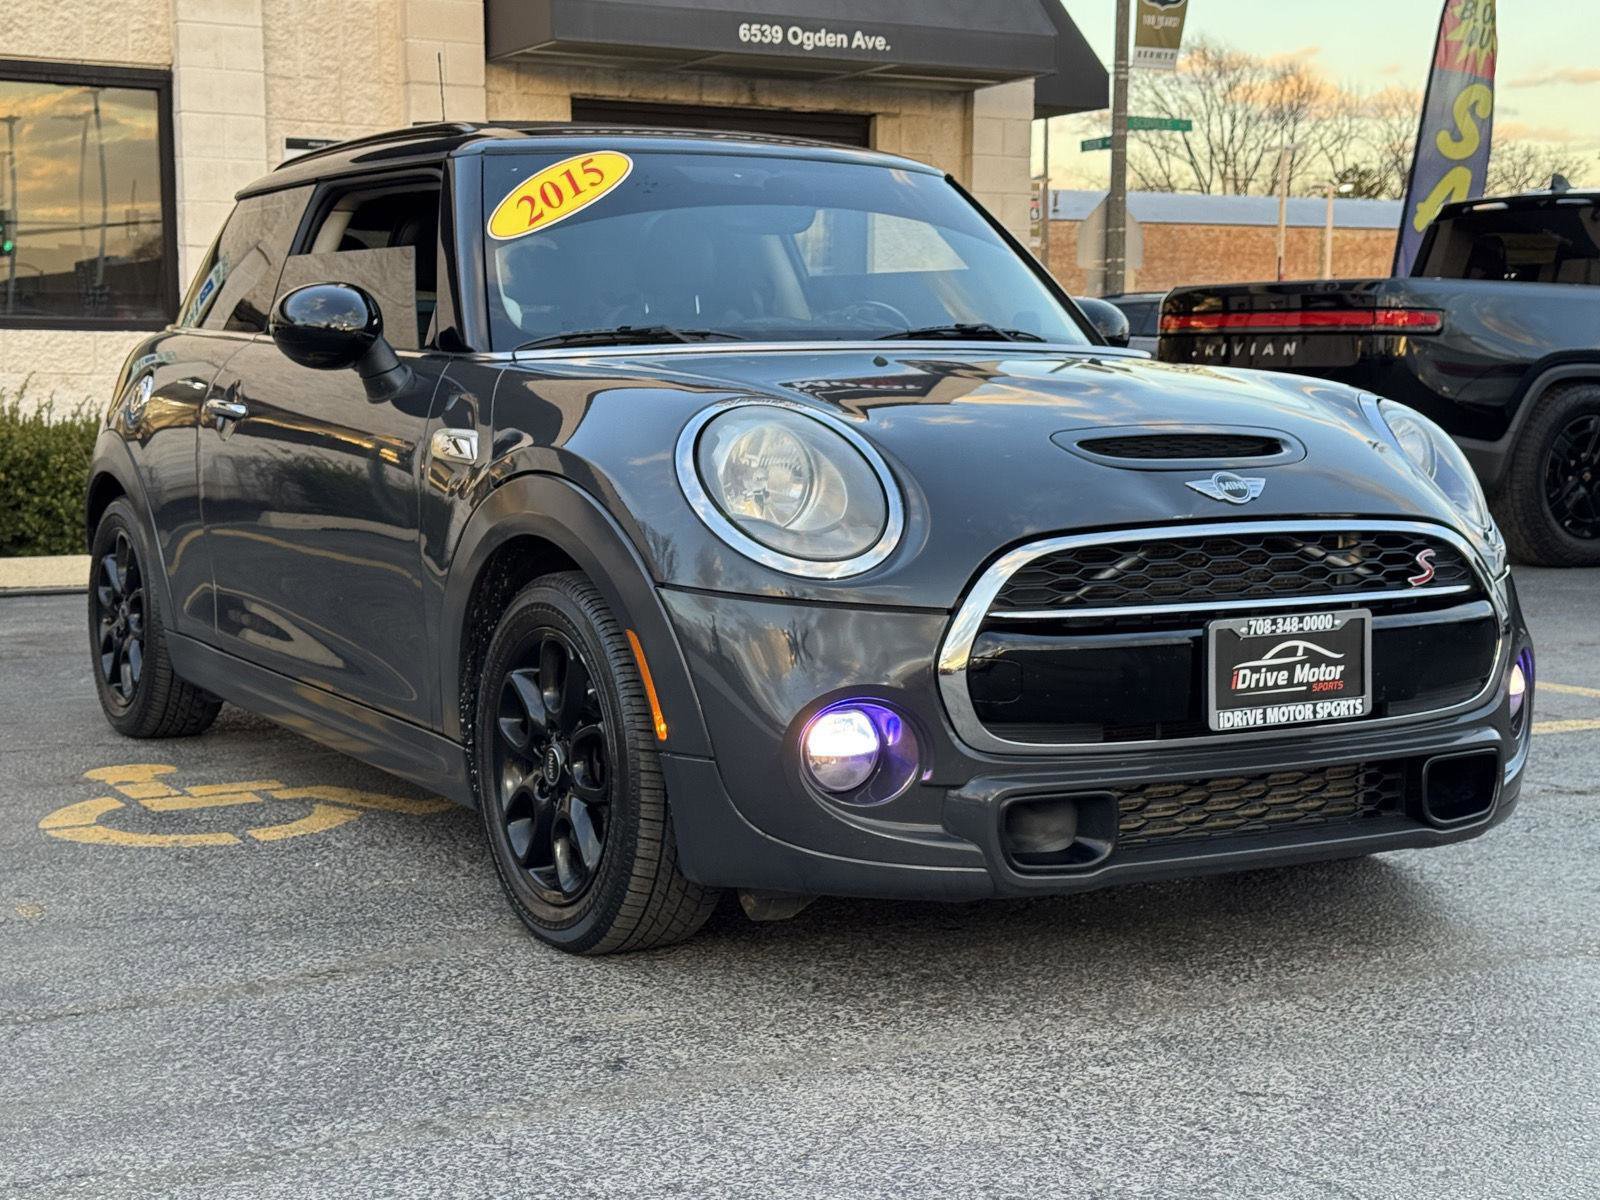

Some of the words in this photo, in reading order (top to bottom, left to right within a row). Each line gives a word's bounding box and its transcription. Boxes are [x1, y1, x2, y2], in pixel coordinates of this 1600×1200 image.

[738, 23, 783, 44] 6539
[787, 26, 848, 50] Ogden
[851, 31, 891, 51] Ave.
[516, 158, 604, 227] 2015
[1407, 548, 1437, 587] S
[1248, 614, 1333, 635] 708-348-0000
[1231, 667, 1289, 690] iDrive
[1293, 663, 1345, 684] Motor
[1311, 680, 1345, 692] SPORTS
[1266, 704, 1314, 724] MOTOR
[1315, 698, 1364, 718] SPORTS
